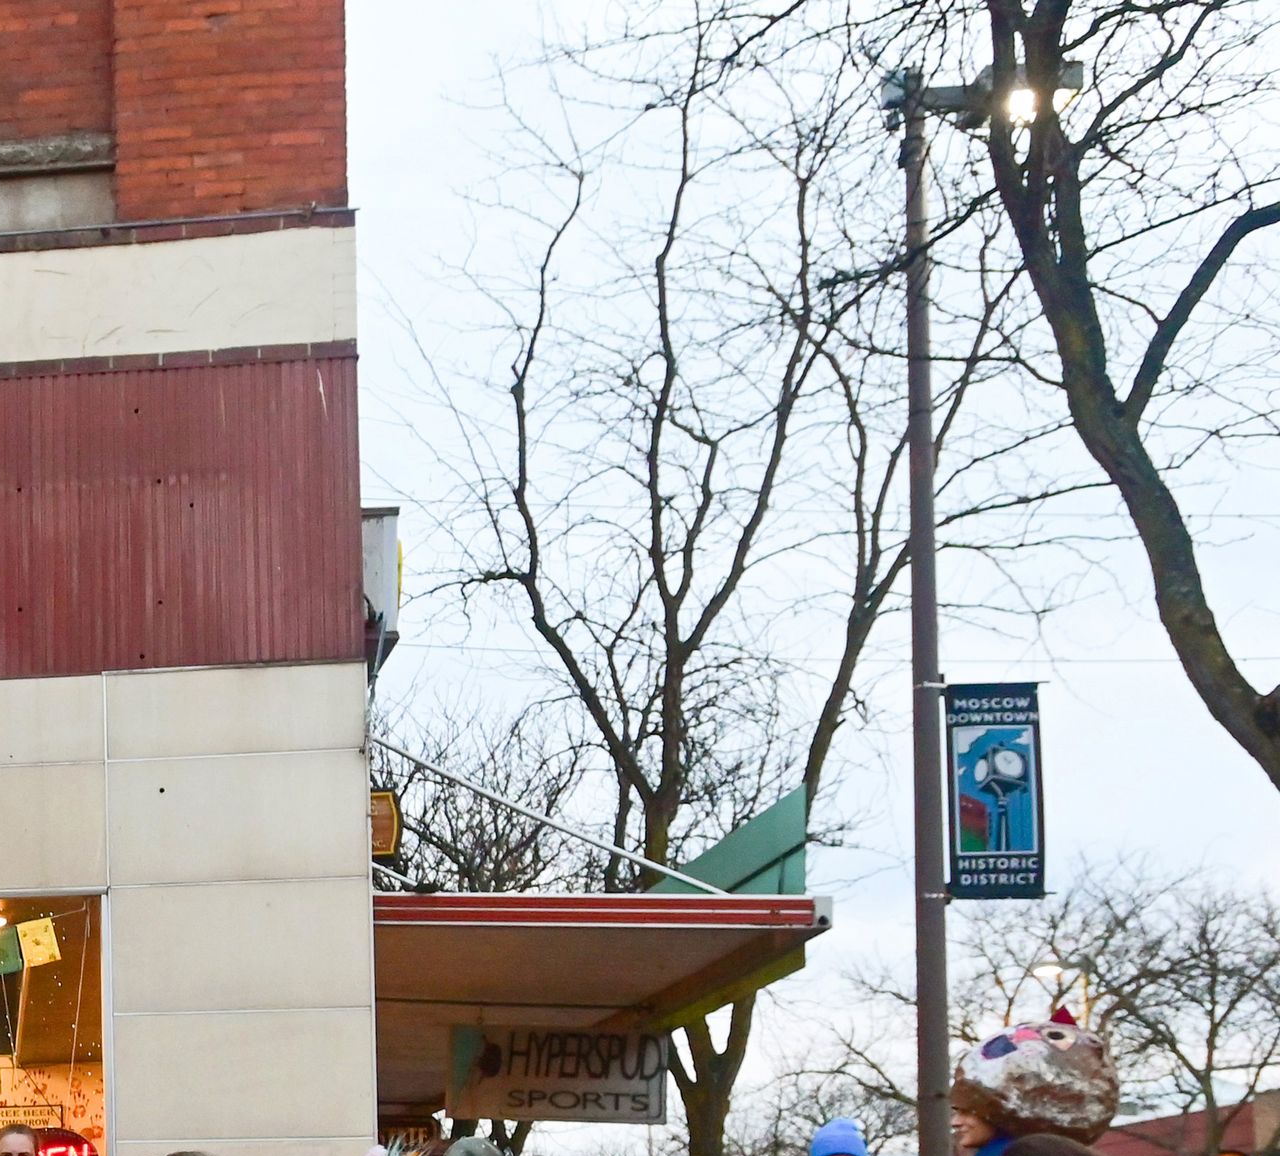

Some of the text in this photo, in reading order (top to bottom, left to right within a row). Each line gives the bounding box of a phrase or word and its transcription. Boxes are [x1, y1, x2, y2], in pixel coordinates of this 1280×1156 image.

[953, 697, 1031, 709] MOSCOW
[947, 711, 1039, 724] DOWNTOWN
[958, 857, 1039, 870] HISTORIC
[960, 872, 1037, 885] DISTRICT
[506, 1030, 663, 1081] HYPERSPUD
[506, 1088, 650, 1112] SPORTS
[23, 1108, 56, 1117] BEER
